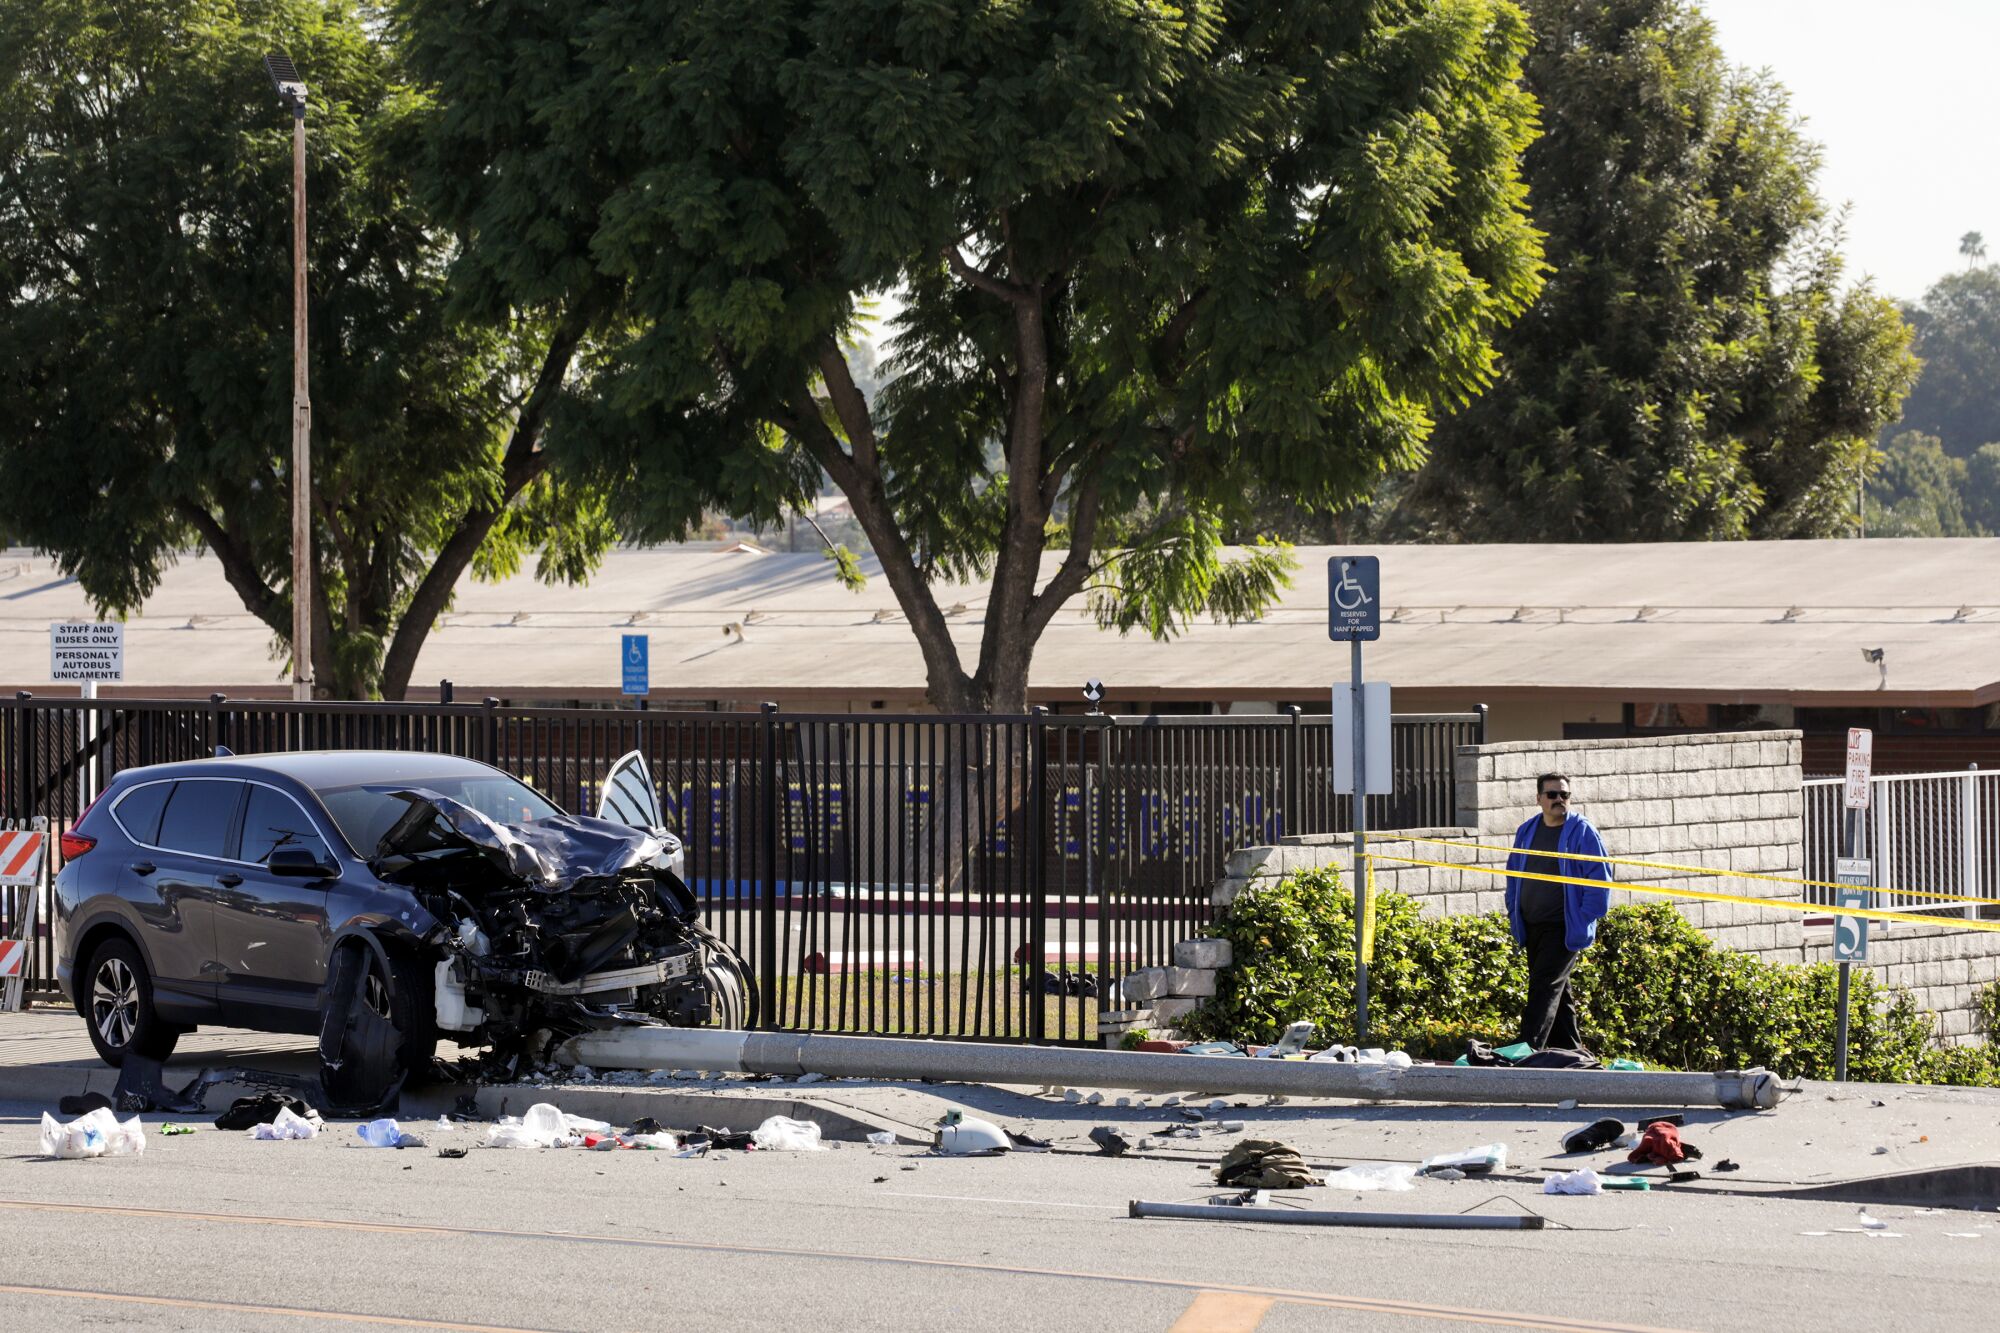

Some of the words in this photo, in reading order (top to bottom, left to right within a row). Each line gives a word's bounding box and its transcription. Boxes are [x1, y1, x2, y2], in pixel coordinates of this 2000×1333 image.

[60, 625, 90, 633] STAFF
[112, 651, 119, 659] Y
[62, 661, 111, 669] AUTOBUS
[1848, 730, 1860, 749] NO
[1848, 751, 1870, 767] PARKING
[1852, 769, 1865, 783] FIRE
[1850, 785, 1866, 799] LANE
[1839, 900, 1861, 954] 5
